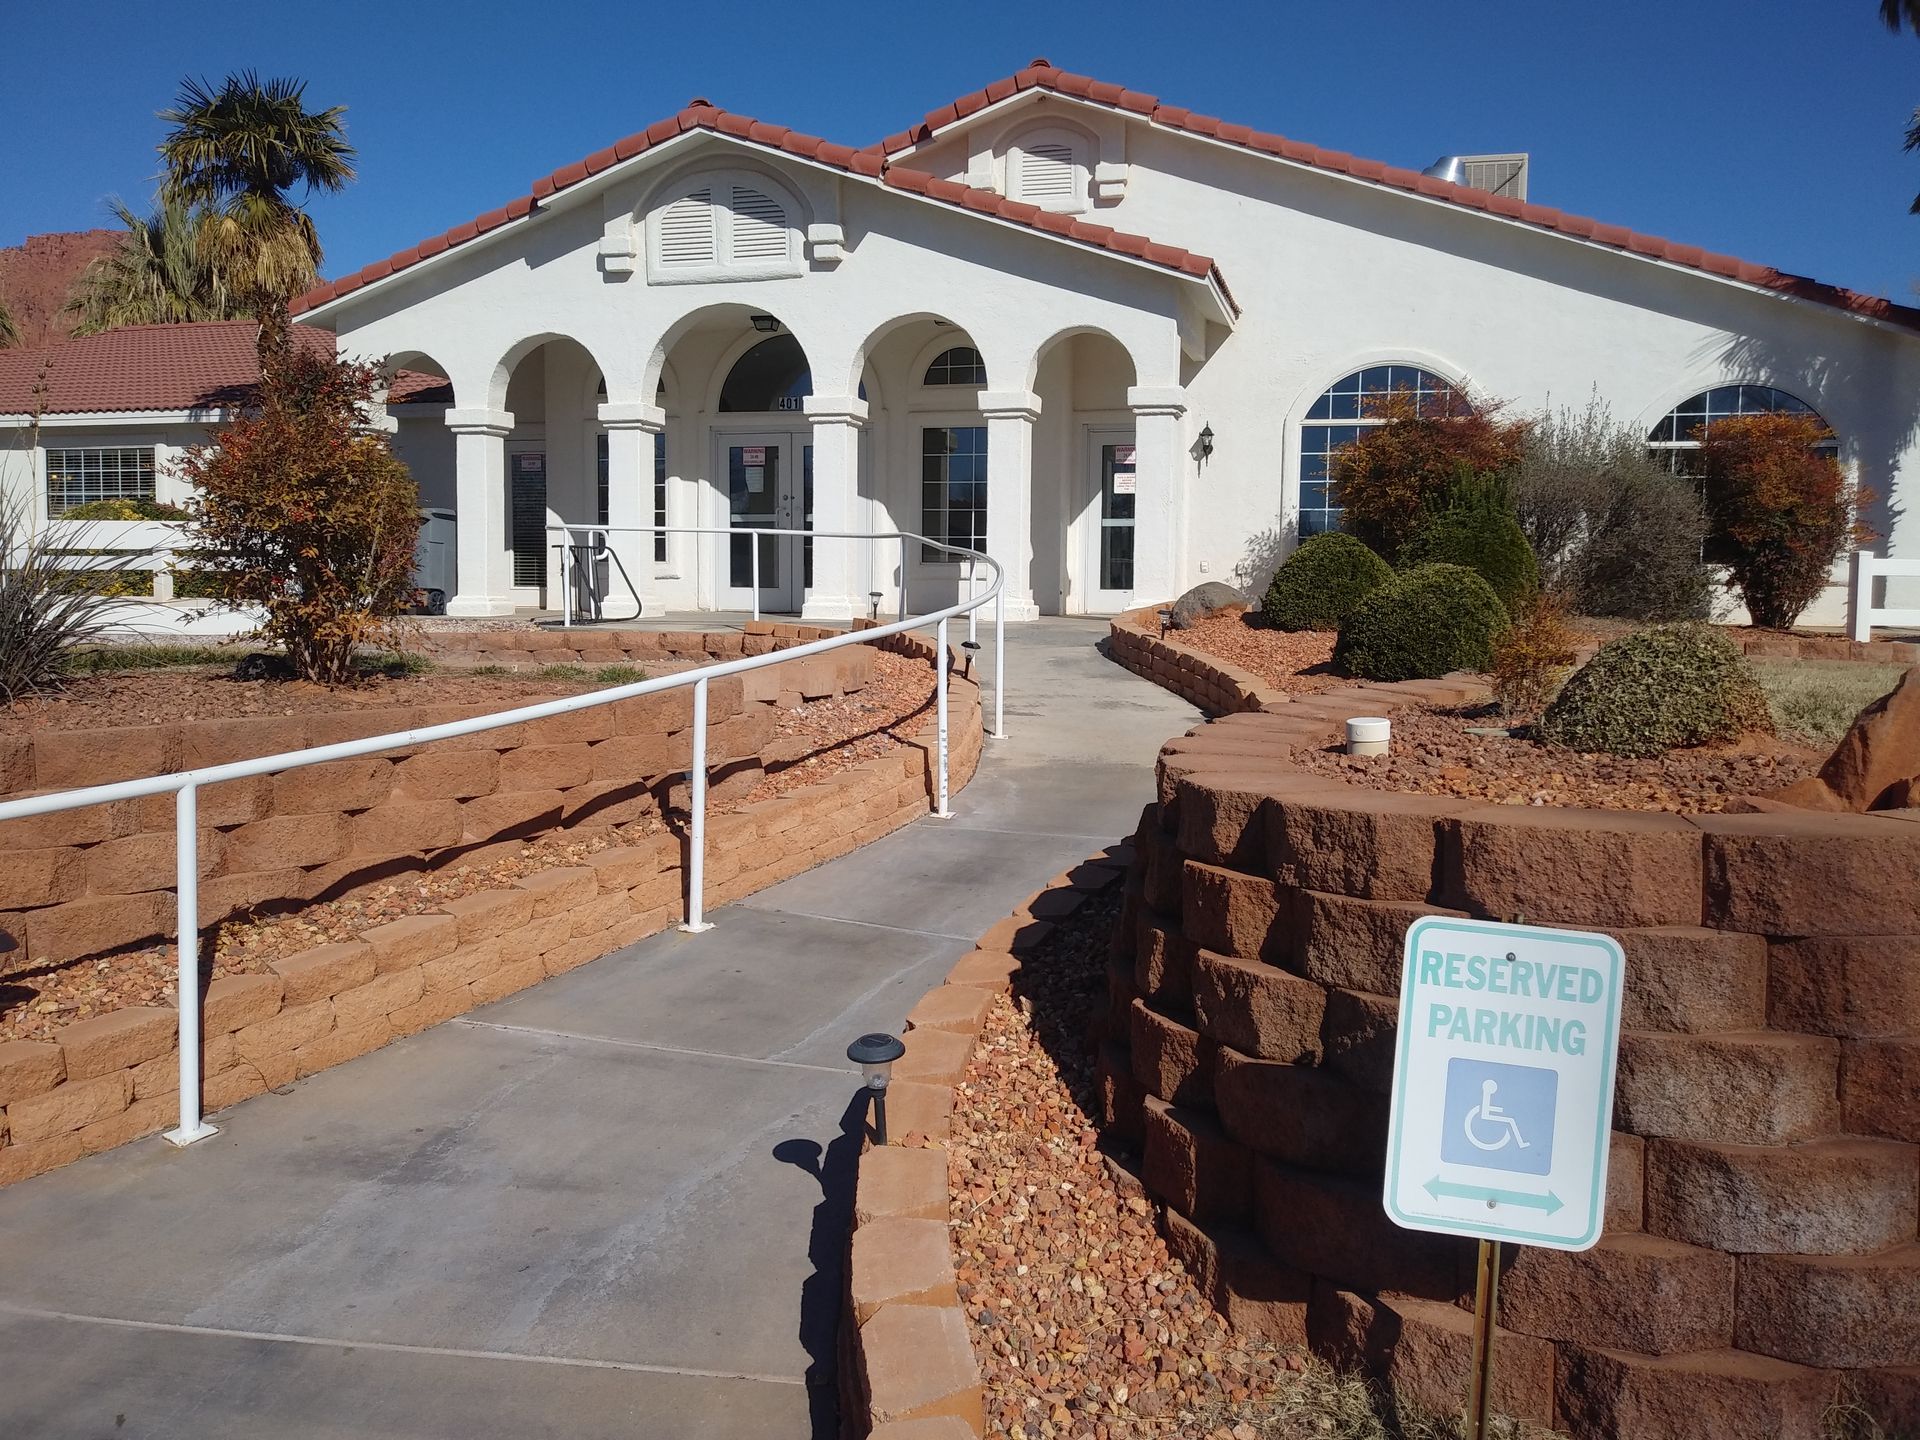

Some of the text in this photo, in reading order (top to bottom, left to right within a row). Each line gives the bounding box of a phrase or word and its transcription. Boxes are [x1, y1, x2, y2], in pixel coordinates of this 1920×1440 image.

[779, 398, 798, 409] 401
[1420, 951, 1603, 1004] RESERVED
[1428, 1004, 1586, 1056] PARKING
